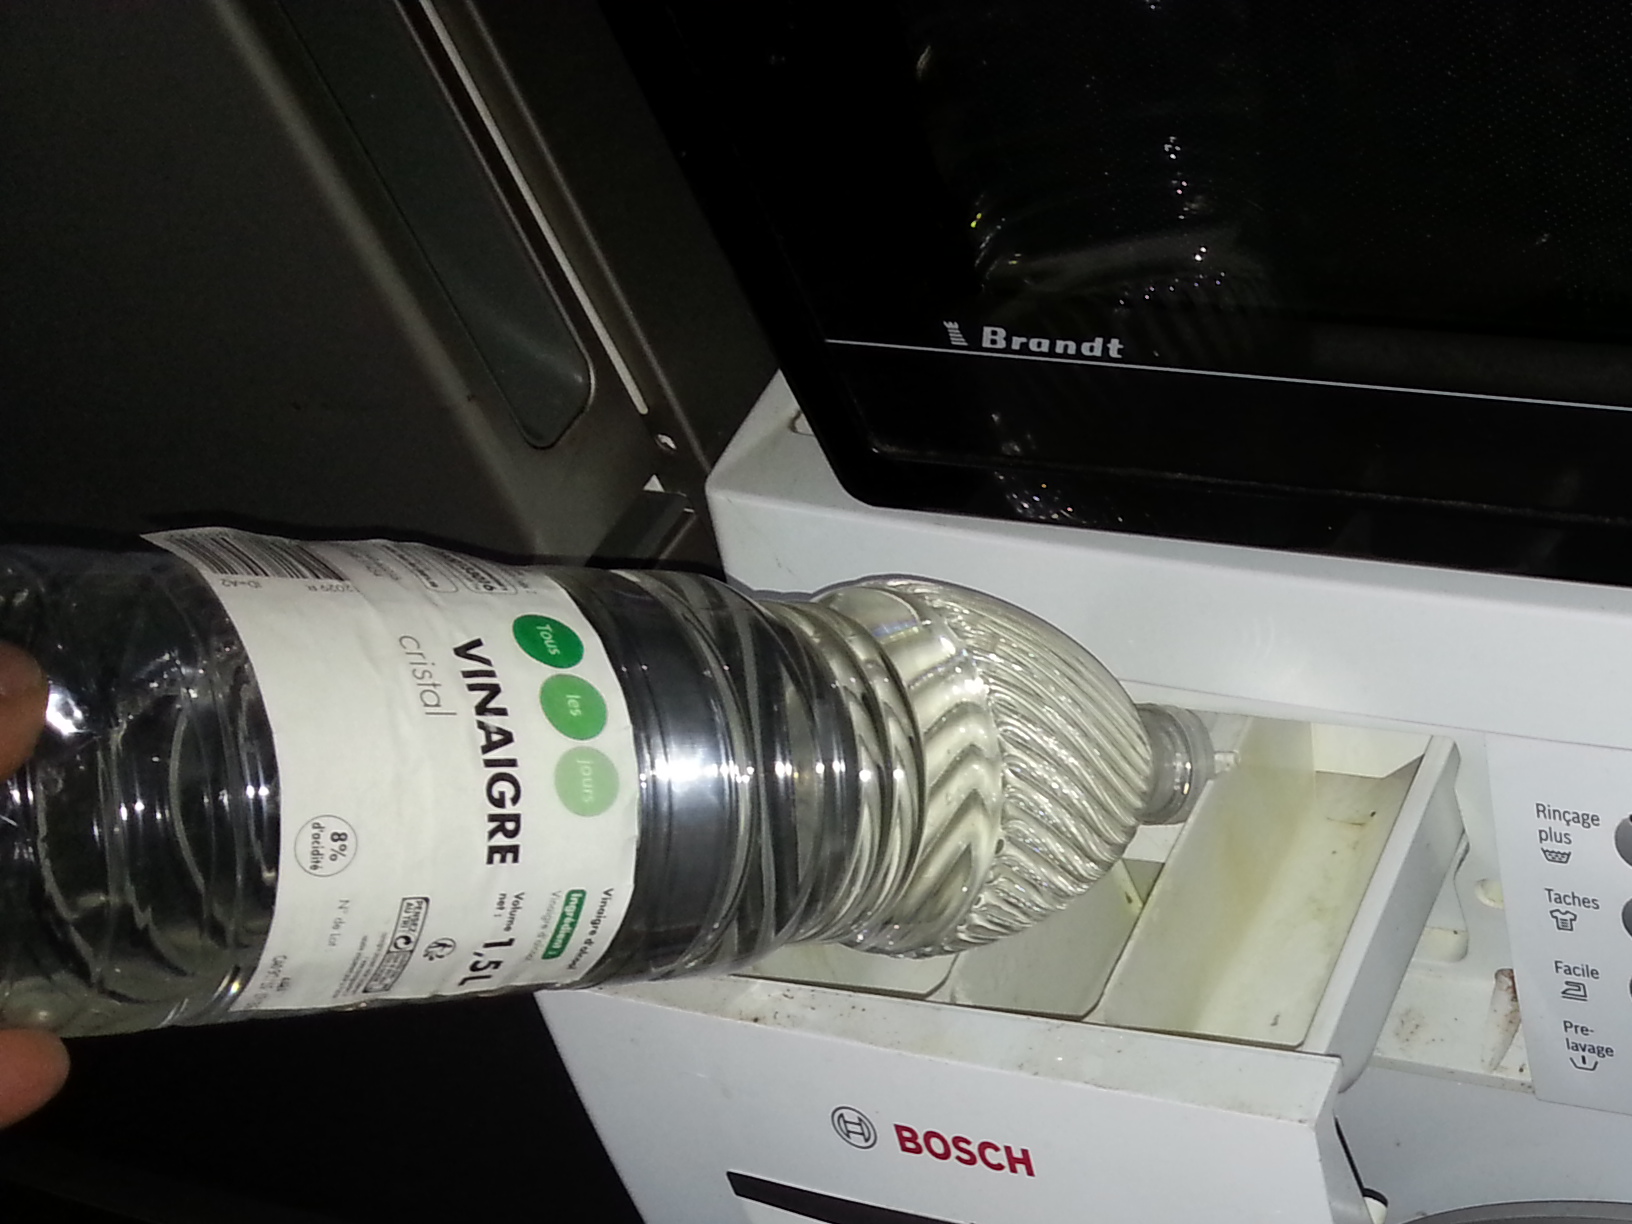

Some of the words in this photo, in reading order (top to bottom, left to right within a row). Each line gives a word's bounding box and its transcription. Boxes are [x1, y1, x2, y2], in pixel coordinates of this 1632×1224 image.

[981, 325, 1124, 359] Brandt
[535, 623, 560, 656] Tous
[398, 634, 457, 717] cristal
[566, 693, 582, 718] les
[453, 637, 521, 865] VINAIGRE
[575, 759, 593, 802] jours
[1535, 803, 1601, 828] Rinçage
[310, 821, 325, 871] d'acidité
[328, 831, 348, 861] 8%
[1538, 826, 1573, 848] plus
[497, 892, 507, 911] net
[504, 892, 525, 931] Volume
[541, 890, 562, 929] Vinaigre
[589, 888, 614, 936] Vinaigre
[1544, 888, 1601, 910] Taches
[332, 917, 346, 930] de
[408, 900, 423, 932] PENSEZ
[552, 893, 583, 949] Ingrédient
[1554, 961, 1600, 980] Facile
[1563, 1019, 1595, 1038] Pre-
[1565, 1037, 1615, 1060] lavage
[893, 1123, 1035, 1177] BOSCH
